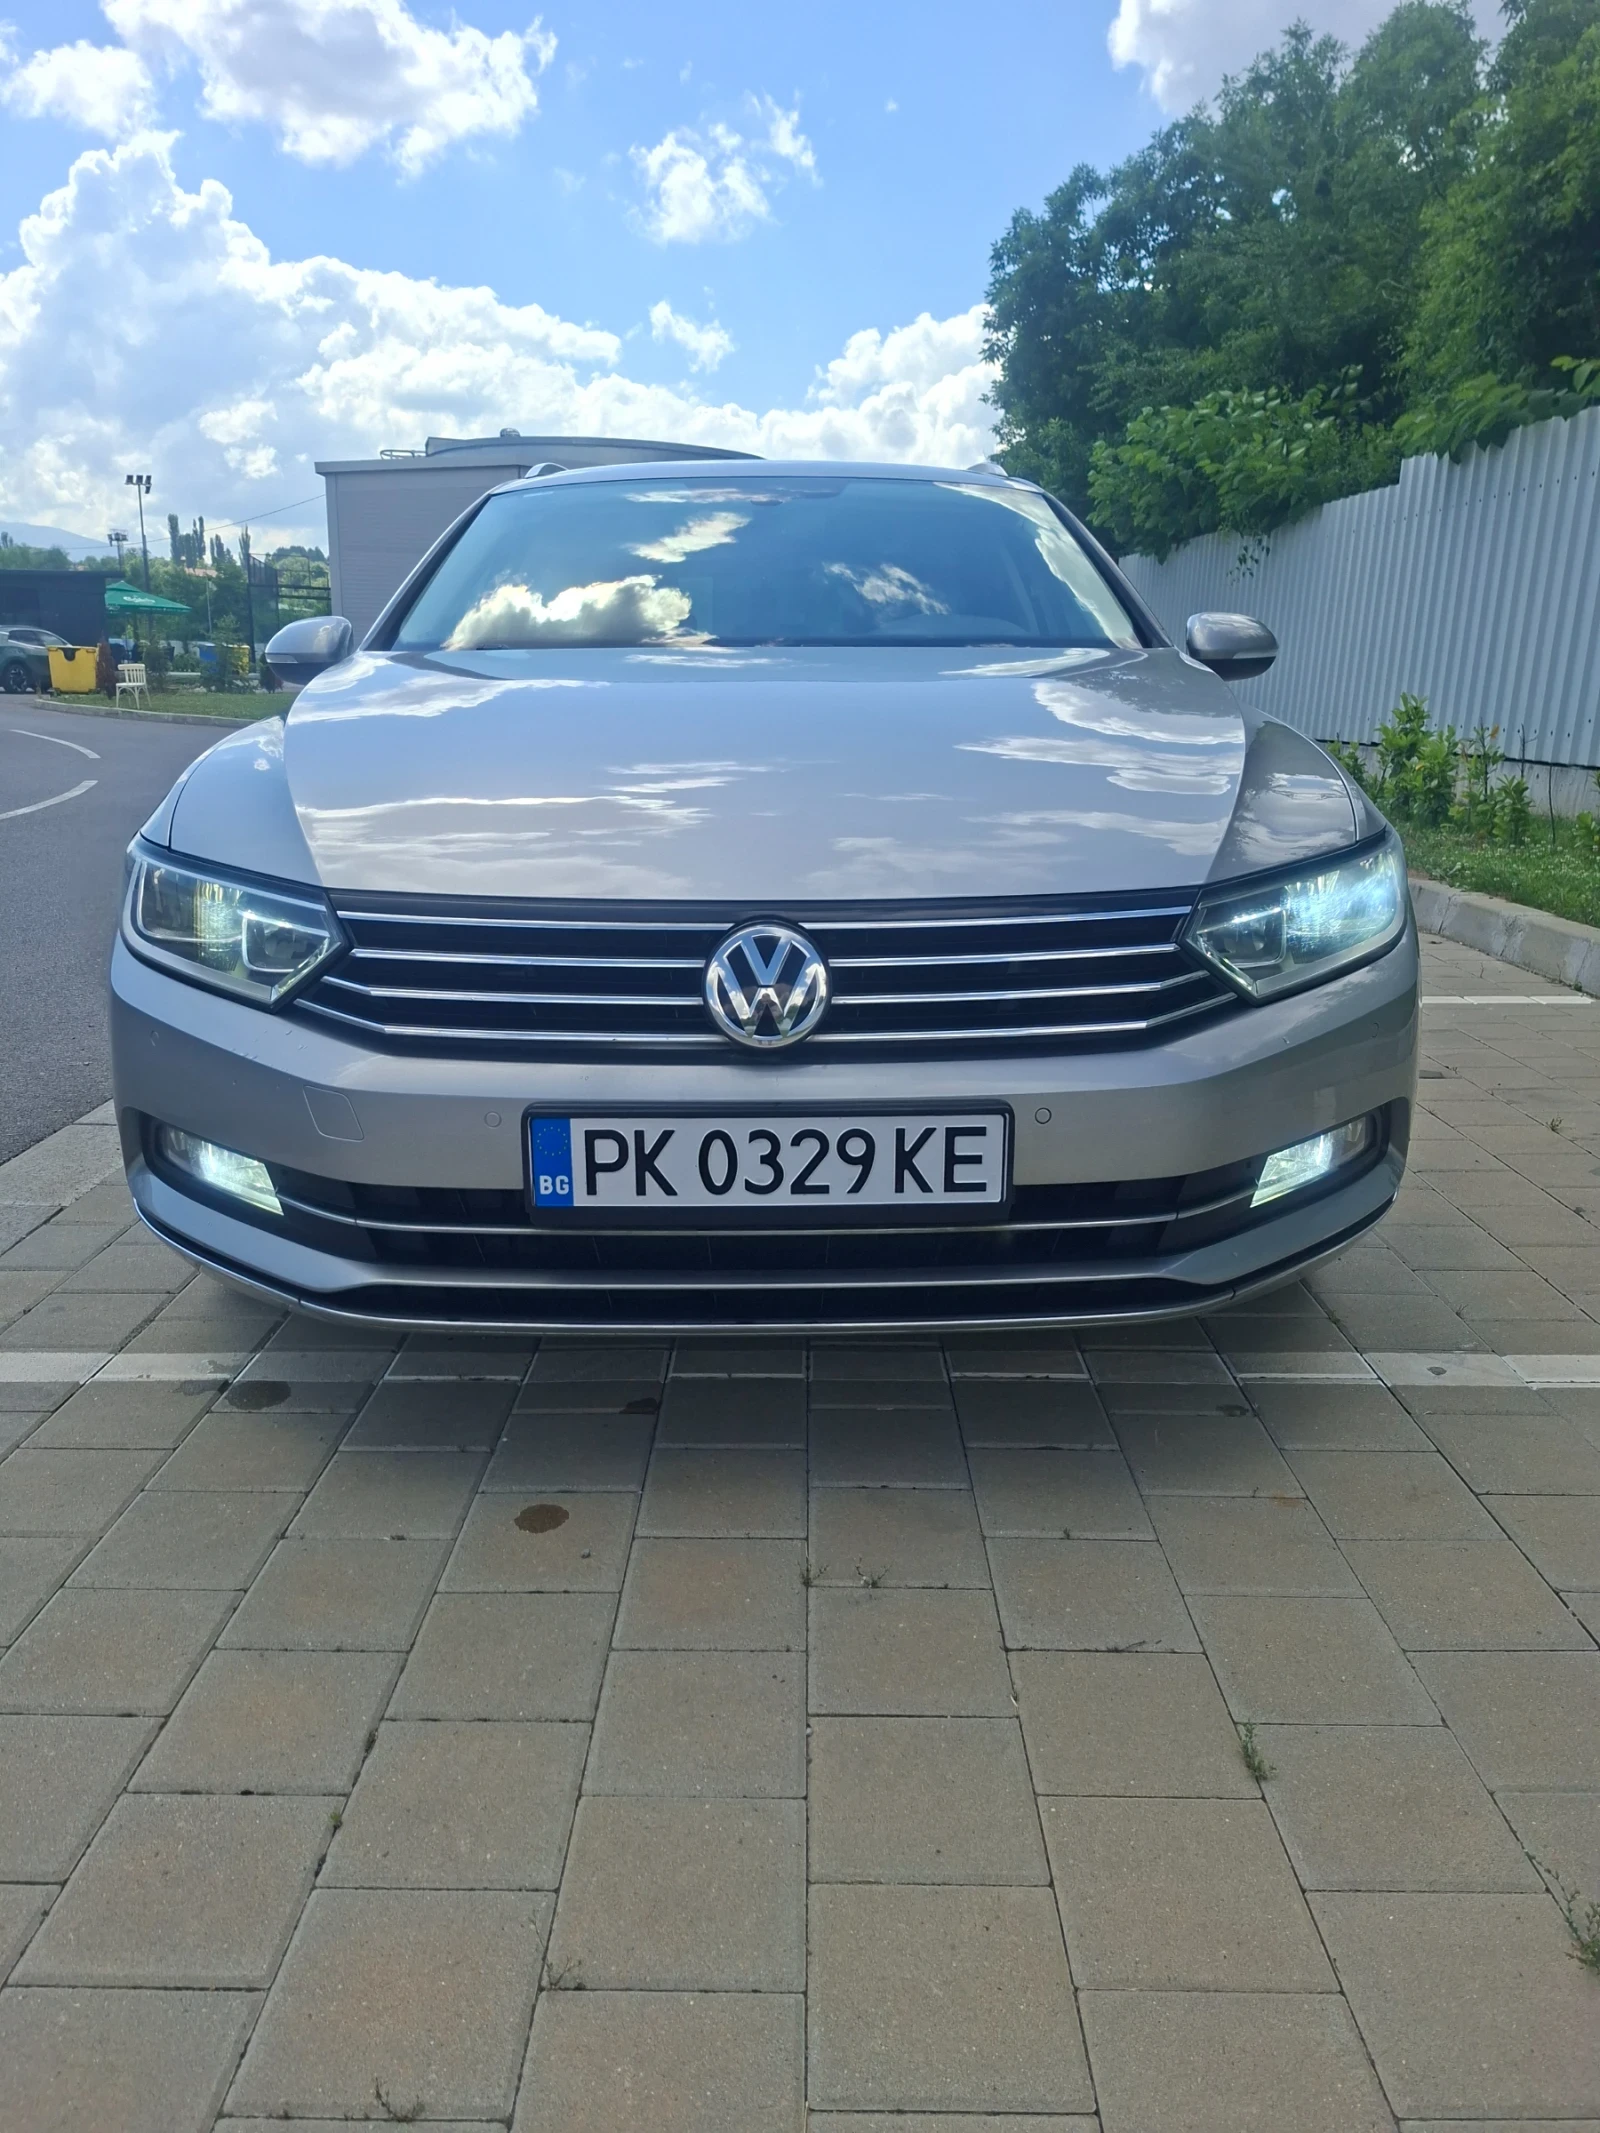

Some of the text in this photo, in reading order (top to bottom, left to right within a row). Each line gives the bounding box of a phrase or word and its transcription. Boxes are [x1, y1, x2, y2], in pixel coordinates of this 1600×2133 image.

[709, 928, 823, 1045] VW
[539, 1175, 569, 1195] BG
[584, 1126, 988, 1196] PK 0329 KE
